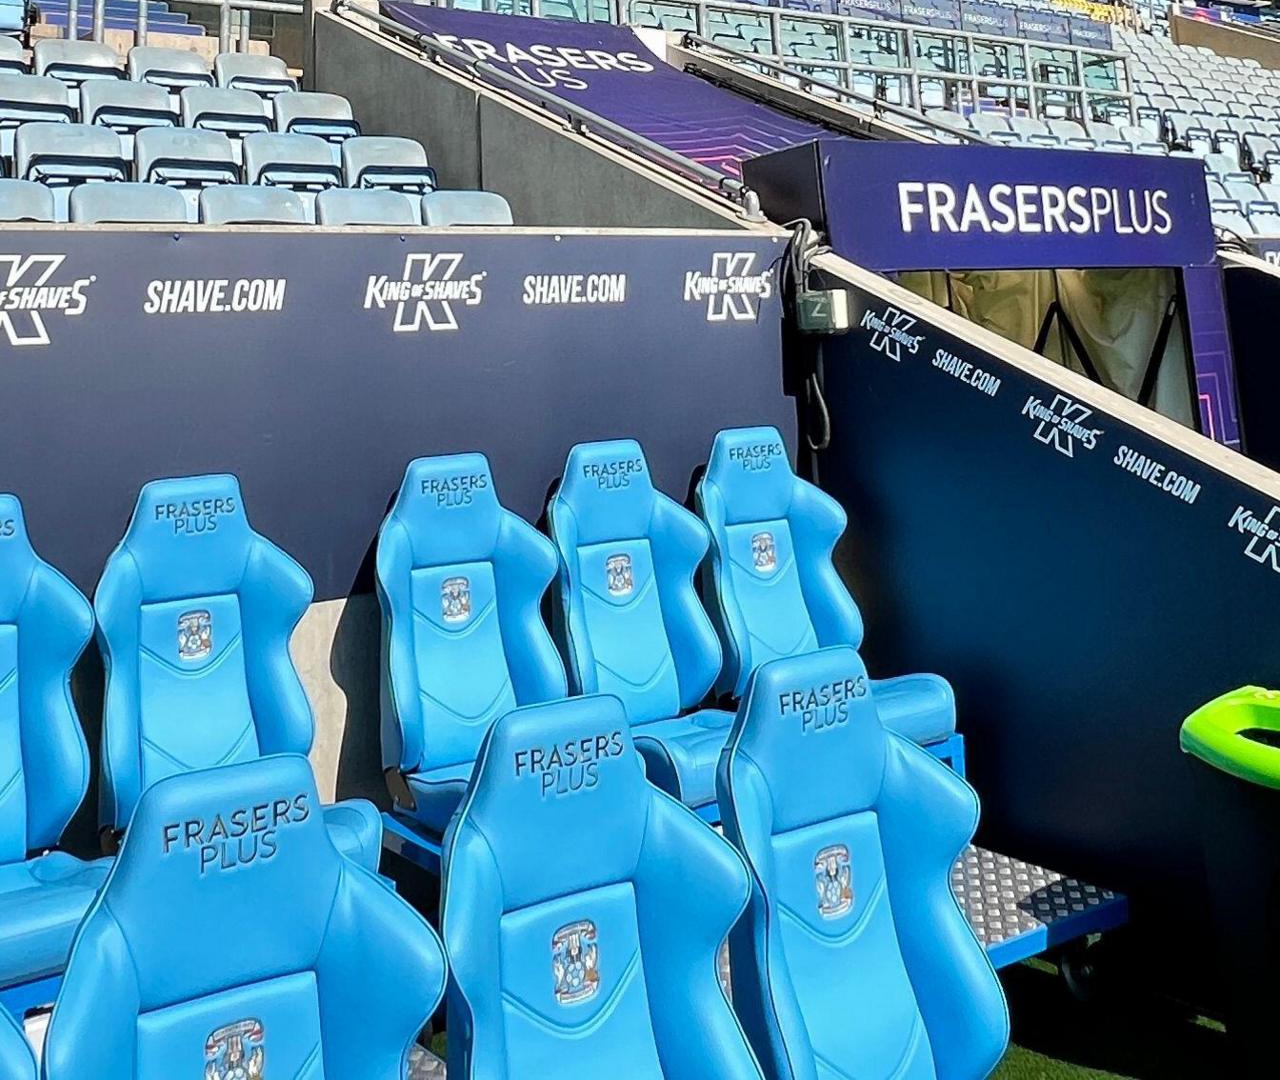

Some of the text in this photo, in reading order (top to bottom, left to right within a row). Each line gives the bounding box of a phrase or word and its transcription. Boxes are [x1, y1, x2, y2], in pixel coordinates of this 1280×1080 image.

[433, 31, 654, 73] FRASERS
[899, 182, 1172, 236] FRASERSPLUS
[6, 278, 90, 316] SHAVES
[143, 279, 286, 314] SHAVE.COM
[364, 275, 411, 308] KING
[422, 274, 483, 305] SHAVES
[523, 274, 626, 304] SHAVE.COM
[684, 271, 718, 301] KING
[727, 270, 771, 299] SHAVES
[931, 349, 1001, 397] SHAVE.COM
[583, 458, 643, 479] FRASERS
[729, 443, 782, 462] FRASERS
[742, 455, 772, 471] PLUS
[421, 474, 487, 495] FRASERS
[597, 473, 630, 490] PLUS
[1114, 446, 1201, 505] SHAVE.COM
[155, 497, 236, 522] FRASERS
[437, 488, 472, 508] PLUS
[173, 514, 217, 536] PLUS
[1228, 505, 1269, 539] KING
[779, 676, 868, 716] FRASERS
[801, 702, 850, 733] PLUS
[514, 729, 625, 778] FRASERS
[540, 763, 600, 797] PLUS
[161, 795, 311, 856] FRASERS
[199, 831, 279, 875] PLUS
